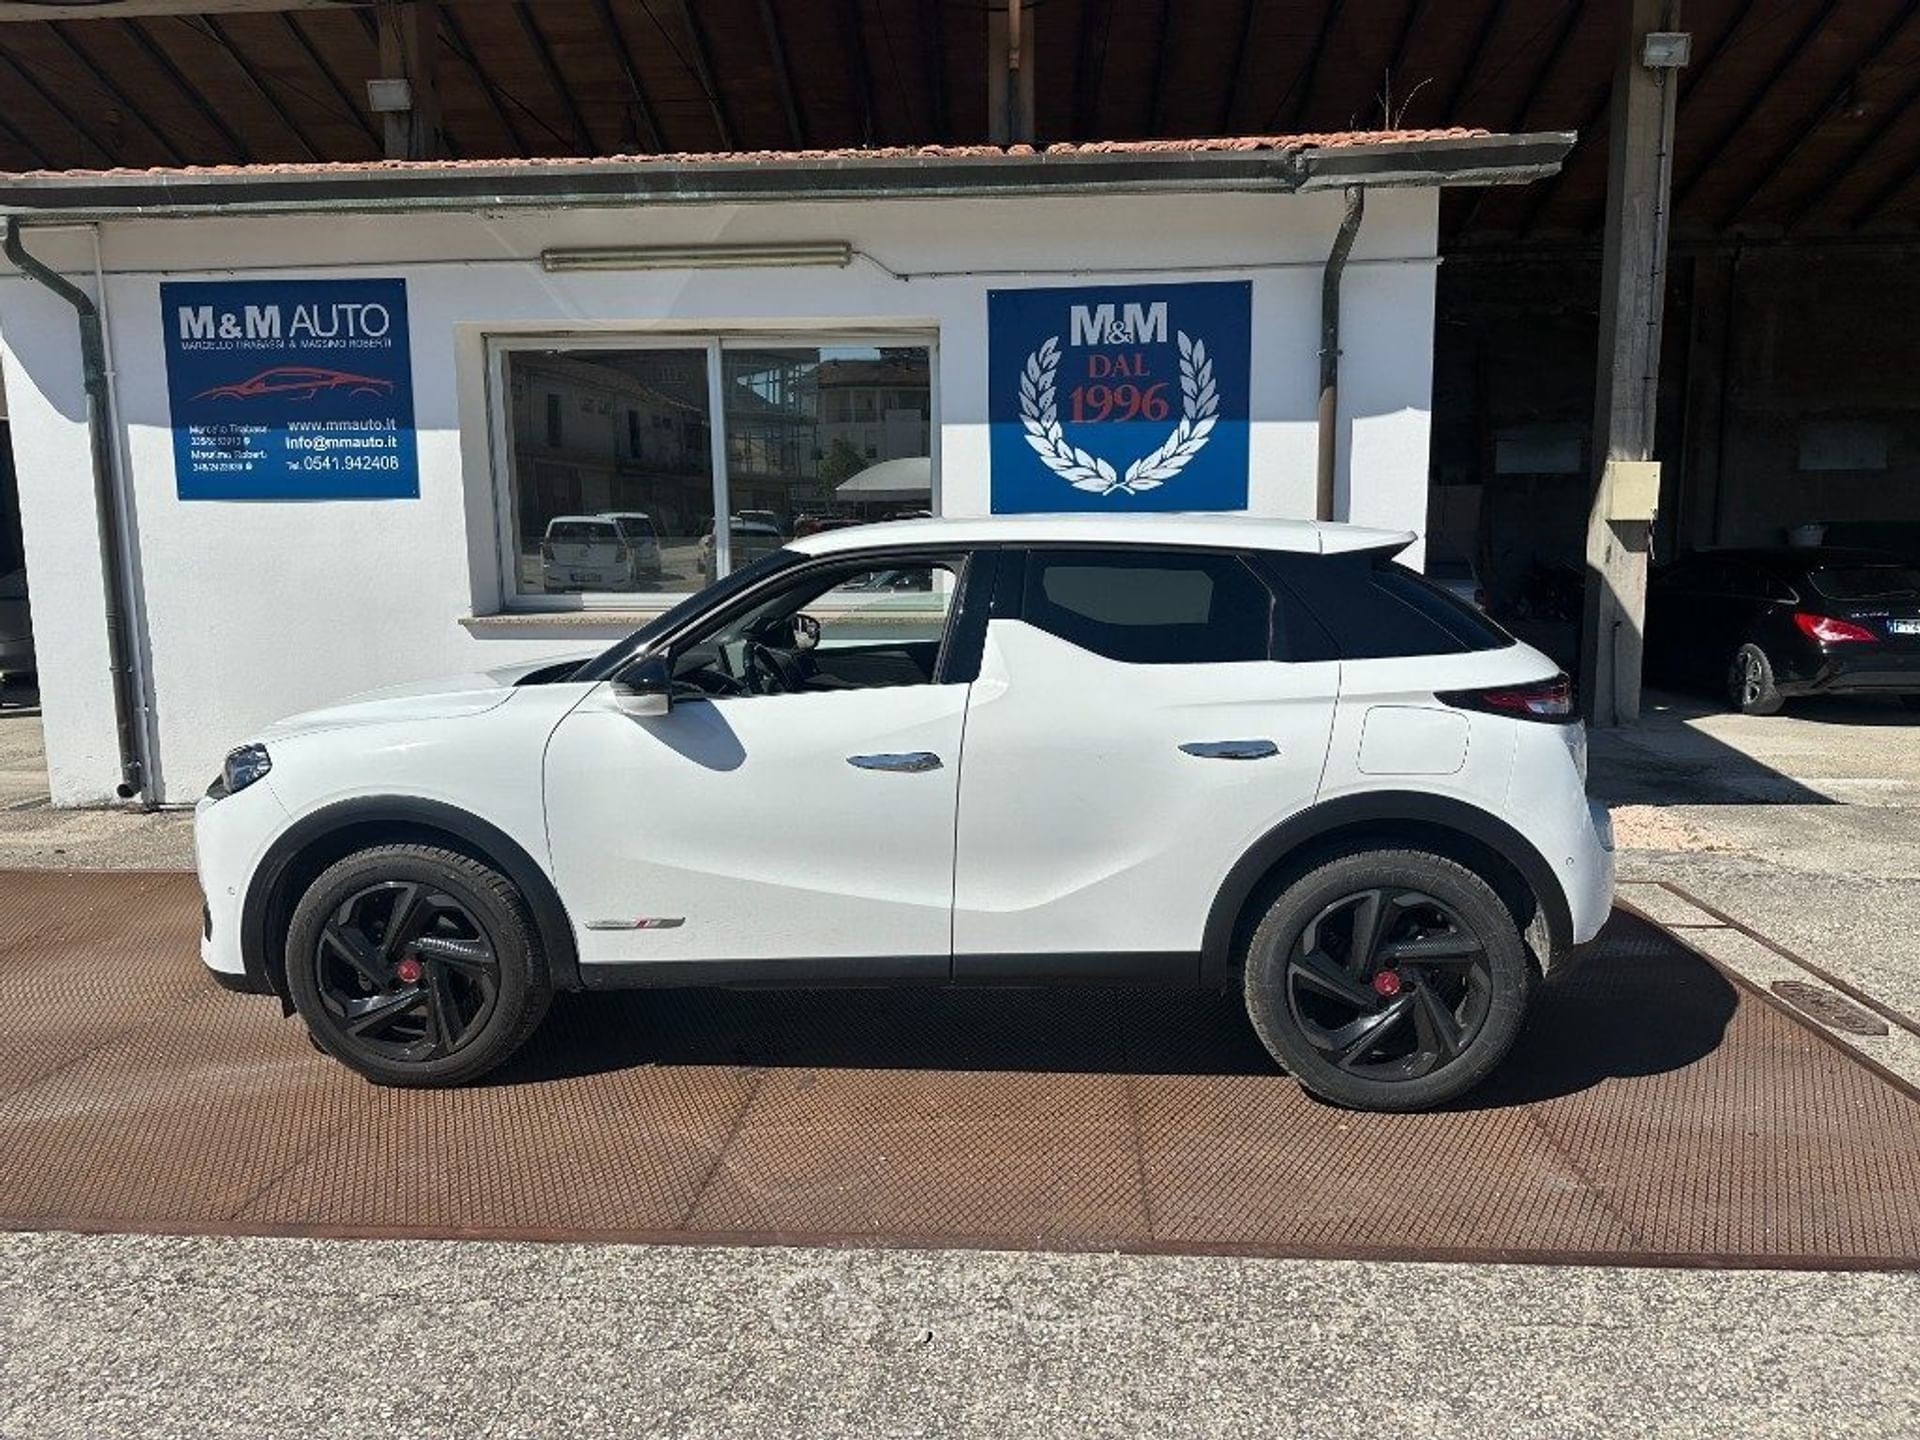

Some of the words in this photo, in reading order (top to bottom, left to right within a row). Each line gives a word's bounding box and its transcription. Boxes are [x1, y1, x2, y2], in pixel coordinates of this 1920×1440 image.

[178, 304, 282, 339] M&M
[289, 303, 390, 338] AUTO
[1070, 301, 1168, 346] M&M
[181, 340, 233, 350] MARCELLO
[288, 339, 296, 349] &
[301, 338, 346, 349] MASSIMO
[349, 337, 392, 348] ROBERTI
[1088, 352, 1150, 378] DAL
[1069, 382, 1170, 424] 1996
[287, 418, 397, 431] www.mmauto.it
